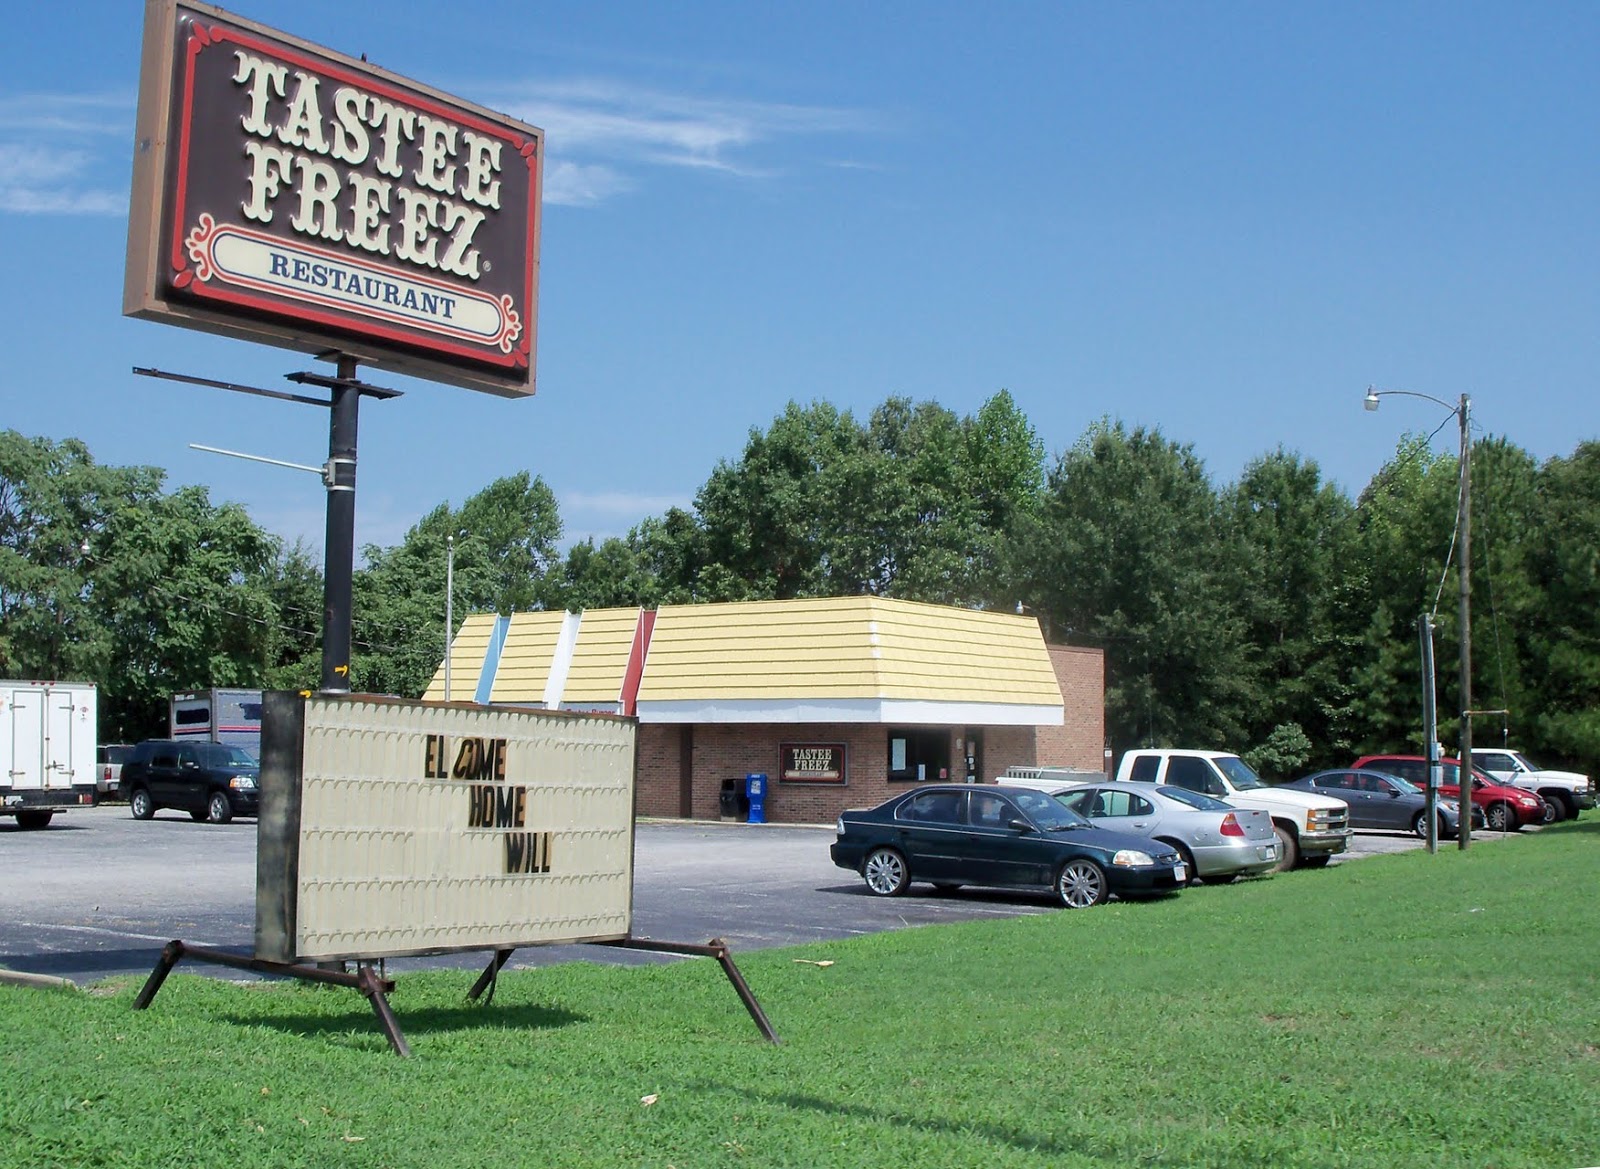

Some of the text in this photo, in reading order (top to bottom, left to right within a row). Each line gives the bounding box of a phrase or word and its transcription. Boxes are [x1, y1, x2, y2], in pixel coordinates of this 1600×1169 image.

[233, 51, 502, 209] TASTEE
[242, 141, 485, 279] FREEZ
[269, 253, 455, 318] RESTAURANT
[793, 749, 832, 760] TASTEE
[795, 760, 829, 770] FREEZ
[468, 785, 526, 828] HOME
[505, 832, 550, 873] WILL
